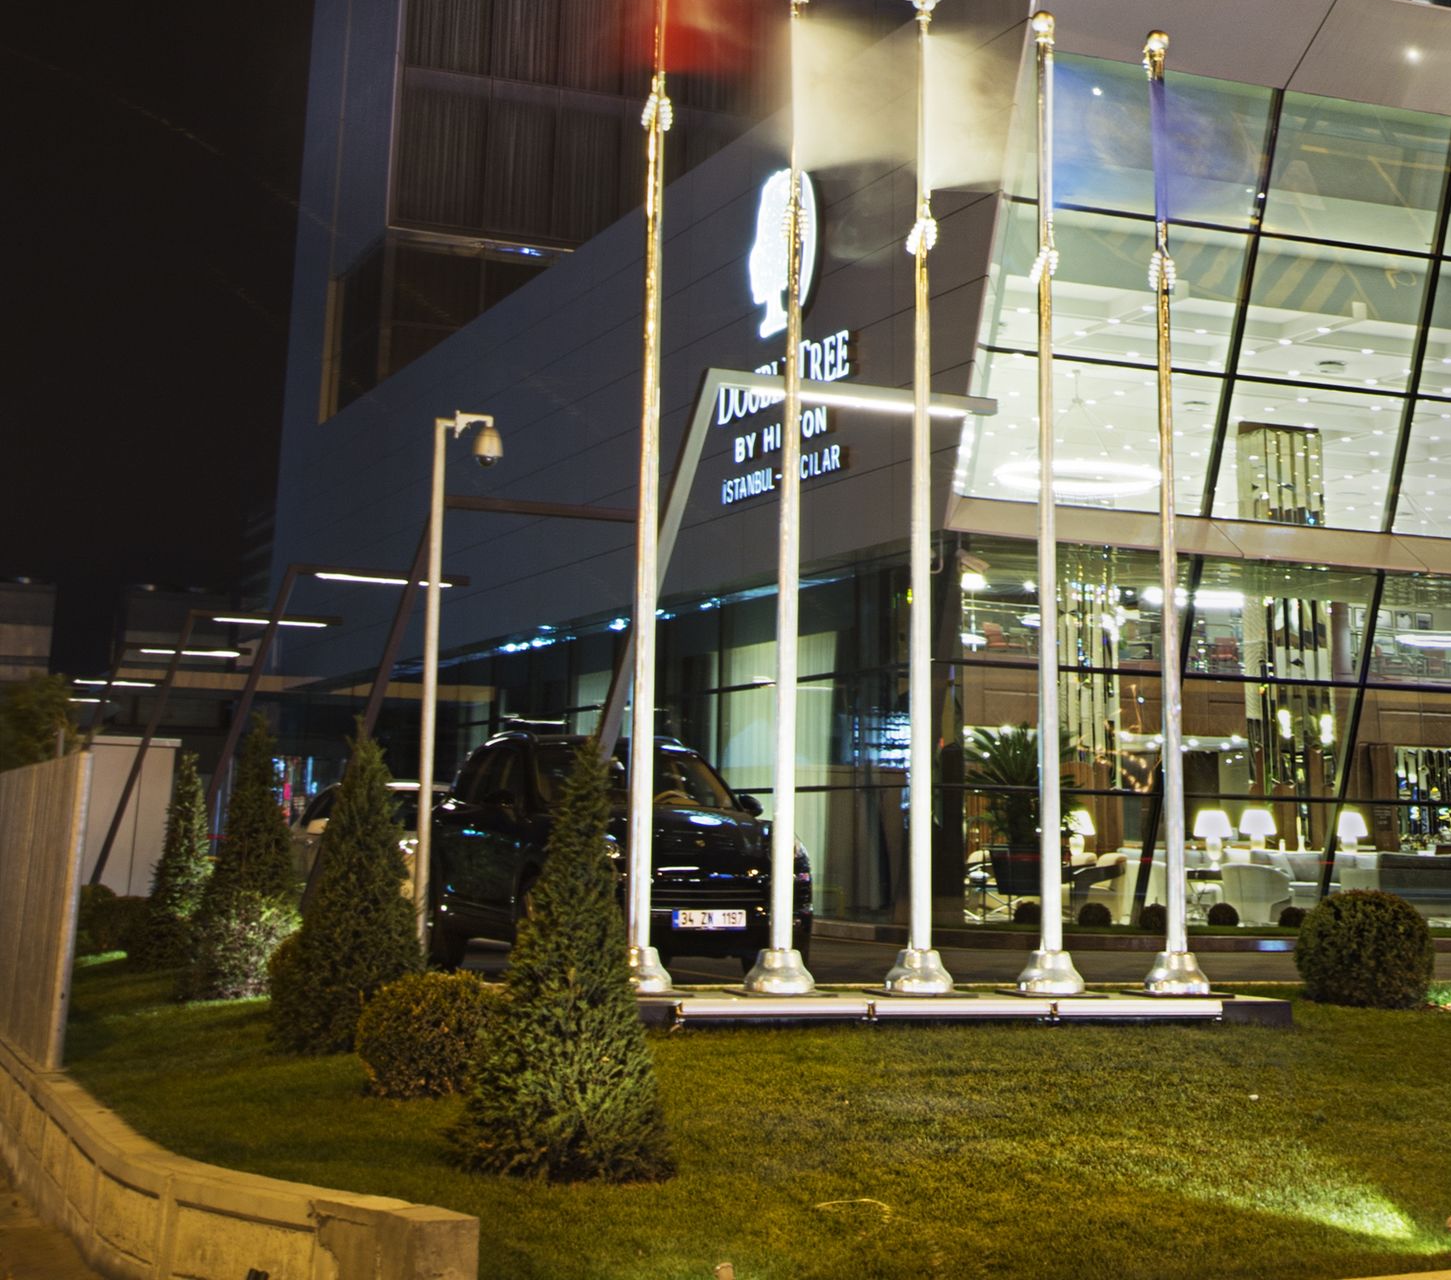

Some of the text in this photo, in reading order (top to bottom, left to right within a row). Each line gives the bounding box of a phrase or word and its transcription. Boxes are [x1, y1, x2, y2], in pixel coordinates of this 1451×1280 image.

[735, 406, 828, 463] BY HION
[681, 912, 694, 925] 34
